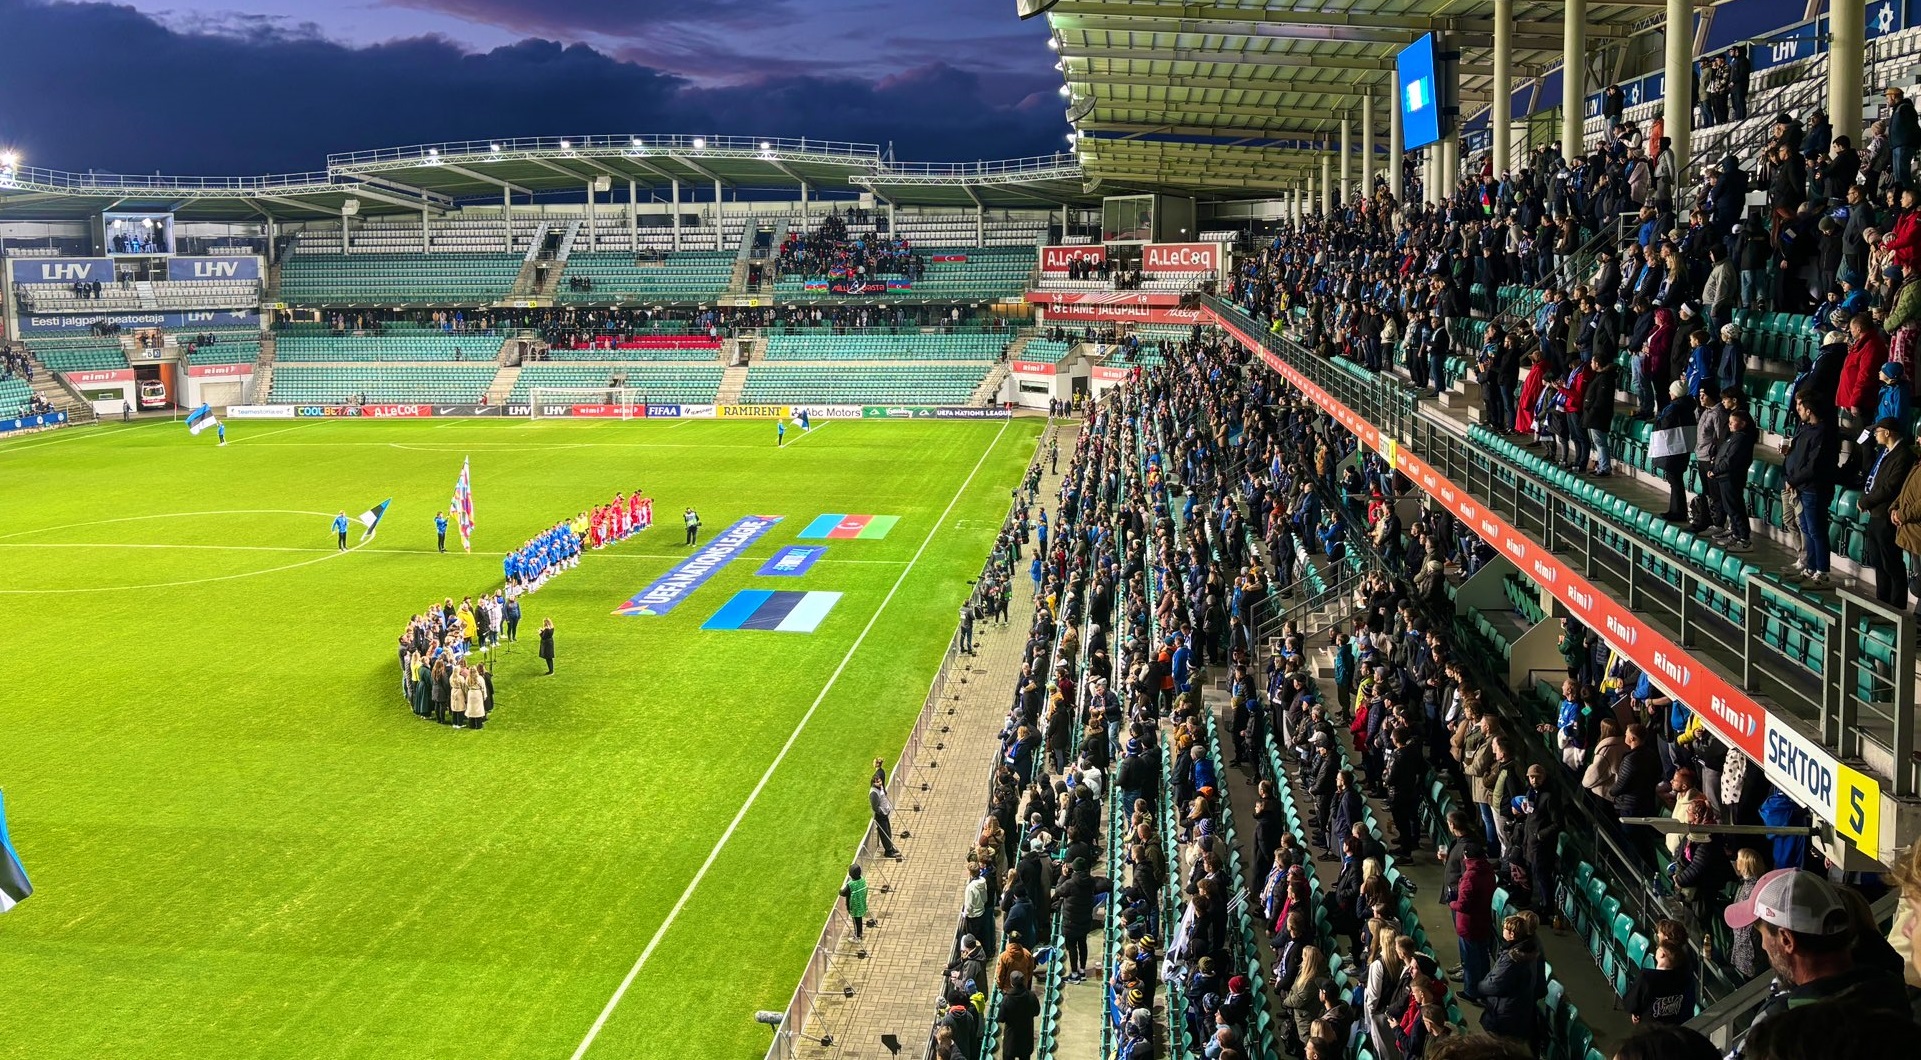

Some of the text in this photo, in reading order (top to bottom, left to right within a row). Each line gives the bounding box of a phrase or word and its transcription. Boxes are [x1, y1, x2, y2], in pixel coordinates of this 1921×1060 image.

[1772, 34, 1799, 62] LHV
[1585, 99, 1598, 117] LHV
[1148, 248, 1210, 268] A.LeCoq
[41, 263, 91, 280] LHV
[194, 261, 239, 278] LHV
[31, 314, 165, 328] Eesti jalgpalli peatoetaja
[188, 312, 215, 321] LHV
[82, 372, 110, 381] Rimi
[203, 366, 229, 374] Rimi
[374, 405, 419, 417] A.LeCoq
[509, 406, 531, 415] LHV
[544, 406, 565, 415] LHV
[724, 406, 783, 416] RAMIRENT
[826, 407, 861, 417] Motors
[1460, 502, 1472, 519] Rimi
[1482, 520, 1495, 537] Rimi
[1506, 538, 1522, 558] Rimi
[638, 521, 768, 604] UEFA NATIONS LEAGUE
[1534, 560, 1553, 582] Rimi
[1567, 584, 1588, 611] Rimi
[1606, 614, 1631, 643] Rimi
[1654, 650, 1683, 684] Rimi
[1711, 693, 1746, 734] Rimi
[1768, 727, 1866, 836] SEKTOR 5
